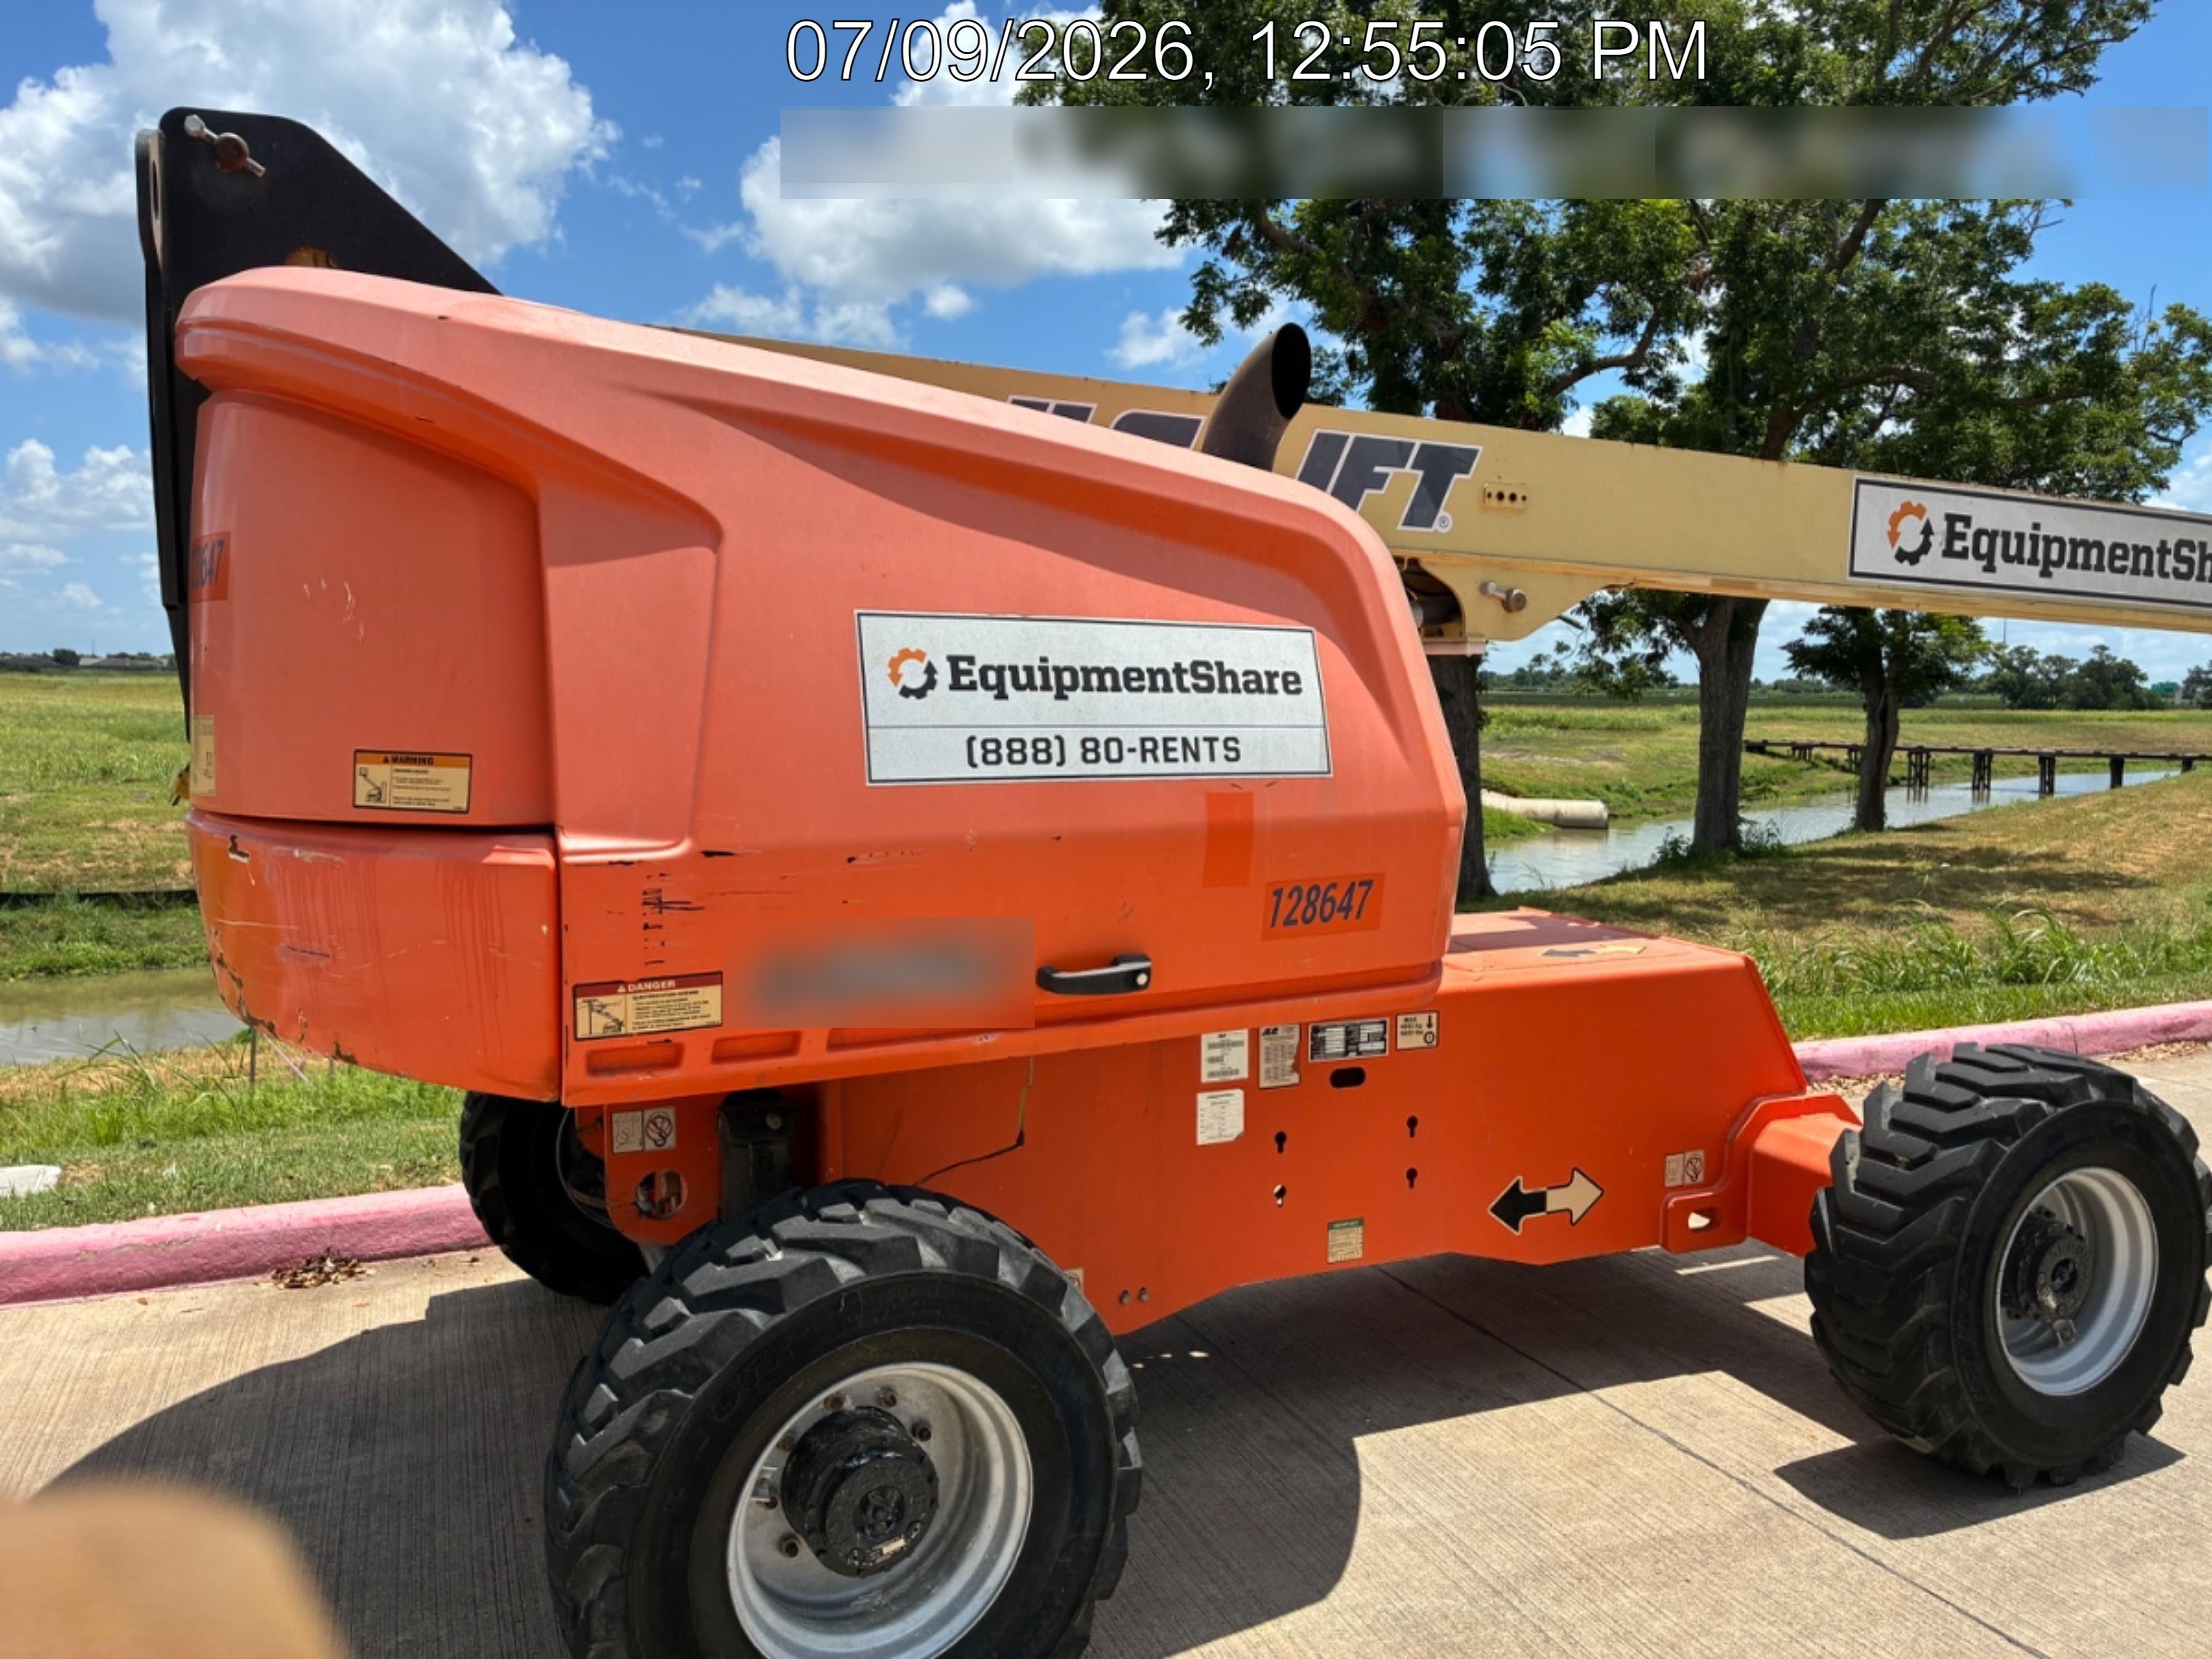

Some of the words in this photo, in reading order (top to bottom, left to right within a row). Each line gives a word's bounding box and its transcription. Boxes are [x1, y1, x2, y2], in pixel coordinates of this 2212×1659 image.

[946, 654, 1303, 700] EquipmentShare
[391, 756, 434, 766] WARNING
[967, 735, 1067, 767] (888)
[1081, 736, 1241, 764] 80-RENTS
[1270, 879, 1373, 928] 128647
[628, 980, 675, 992] DANGER
